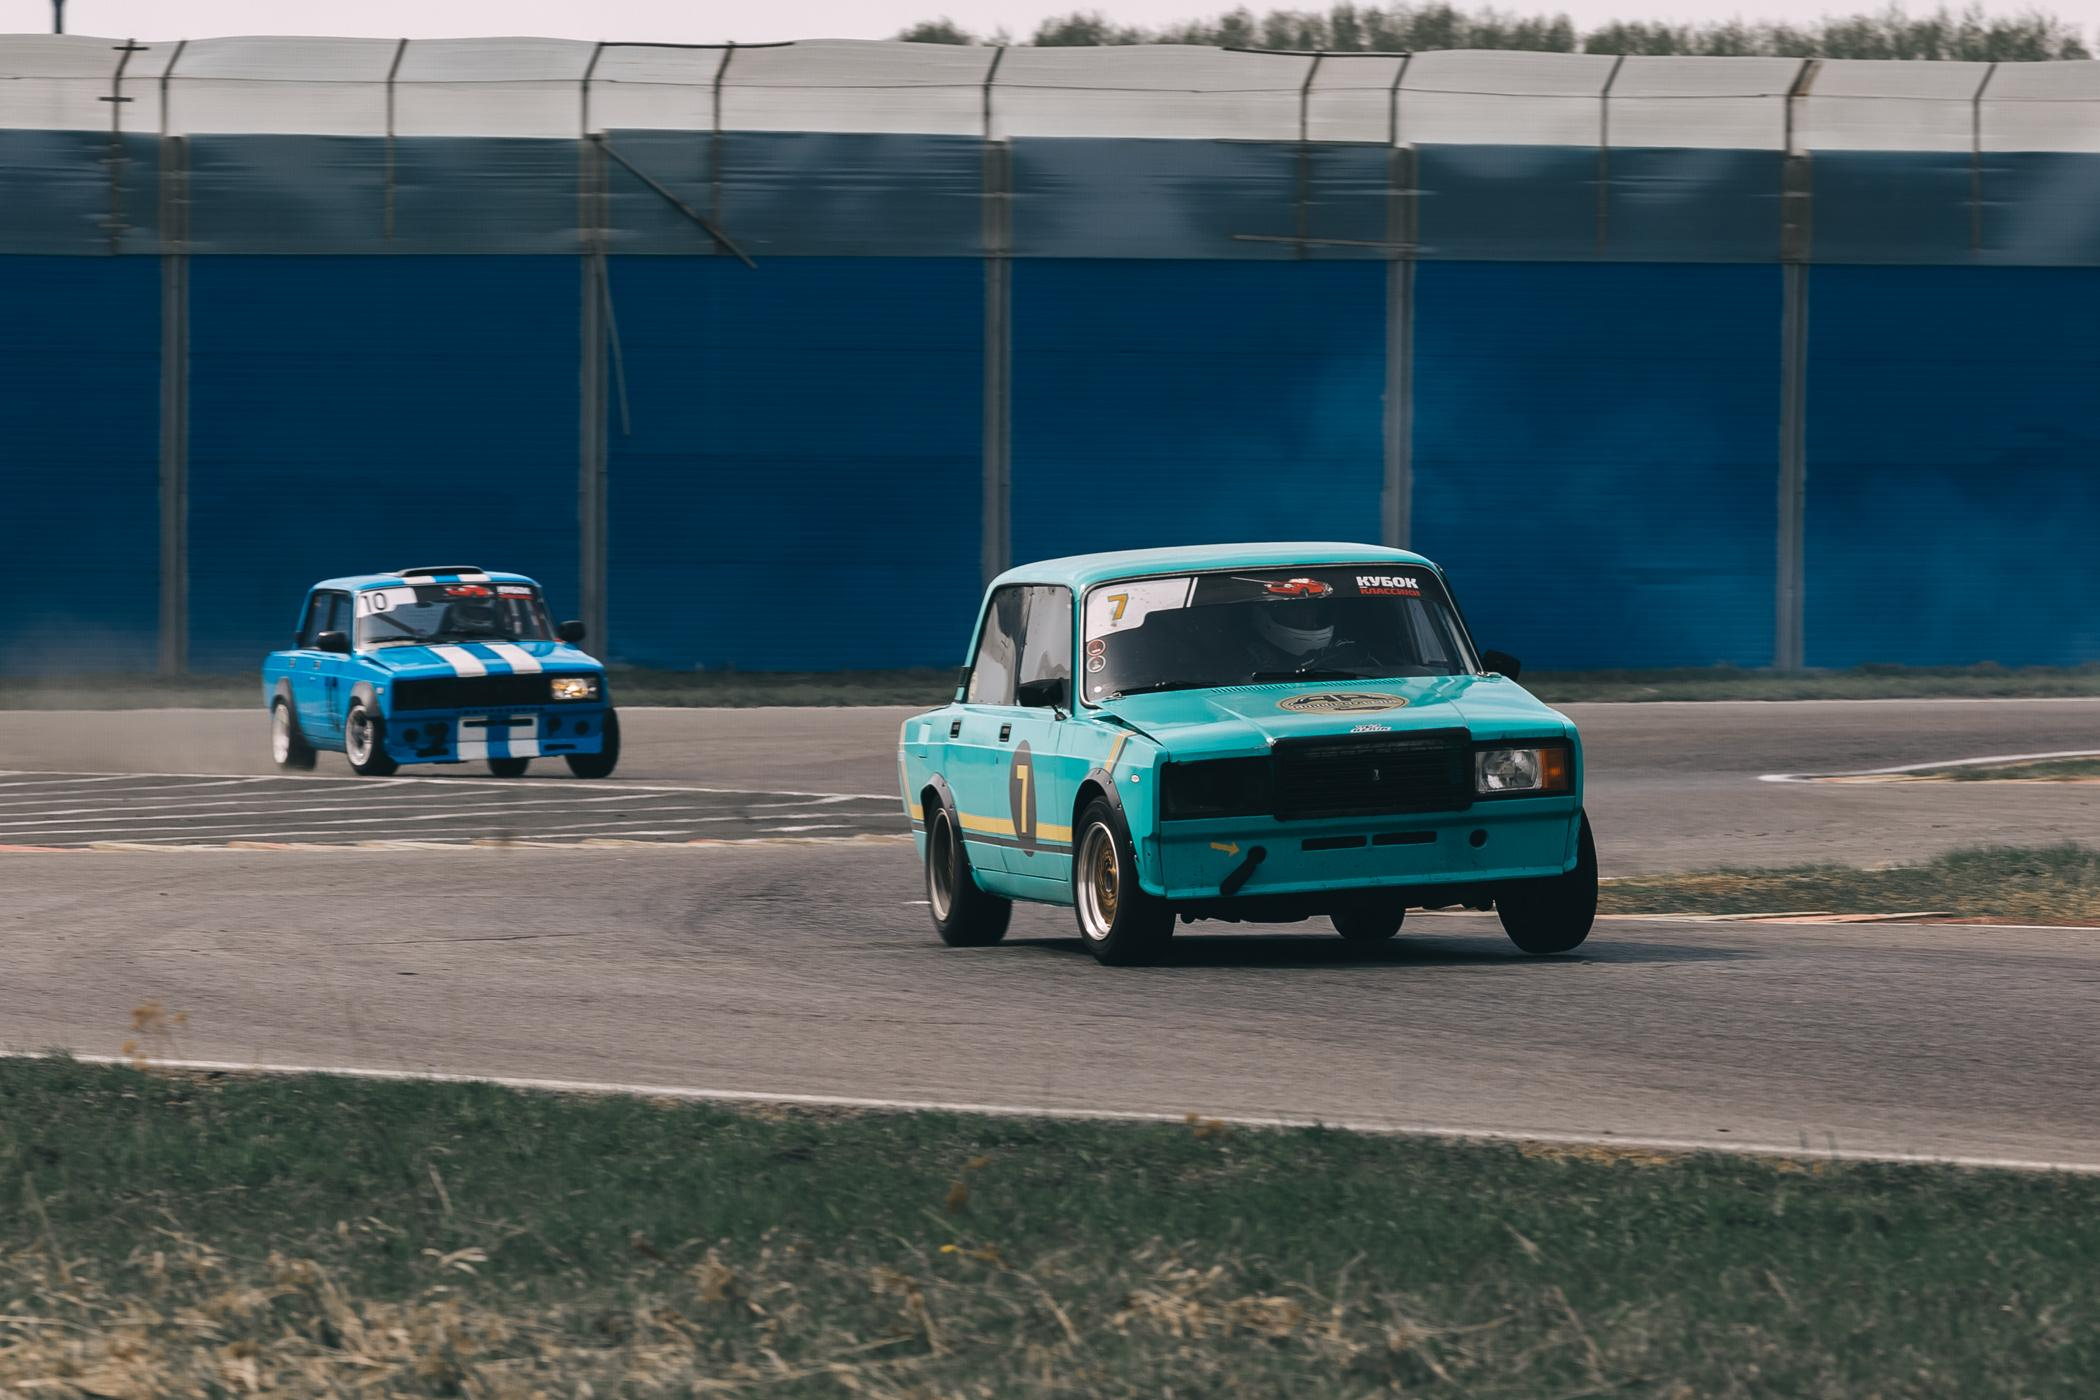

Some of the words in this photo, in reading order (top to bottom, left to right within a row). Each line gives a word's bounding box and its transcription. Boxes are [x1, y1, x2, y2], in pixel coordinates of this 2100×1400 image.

[1355, 576, 1419, 588] КУБОК
[361, 592, 388, 612] 10
[1107, 592, 1129, 621] 7
[1016, 765, 1028, 833] 7
